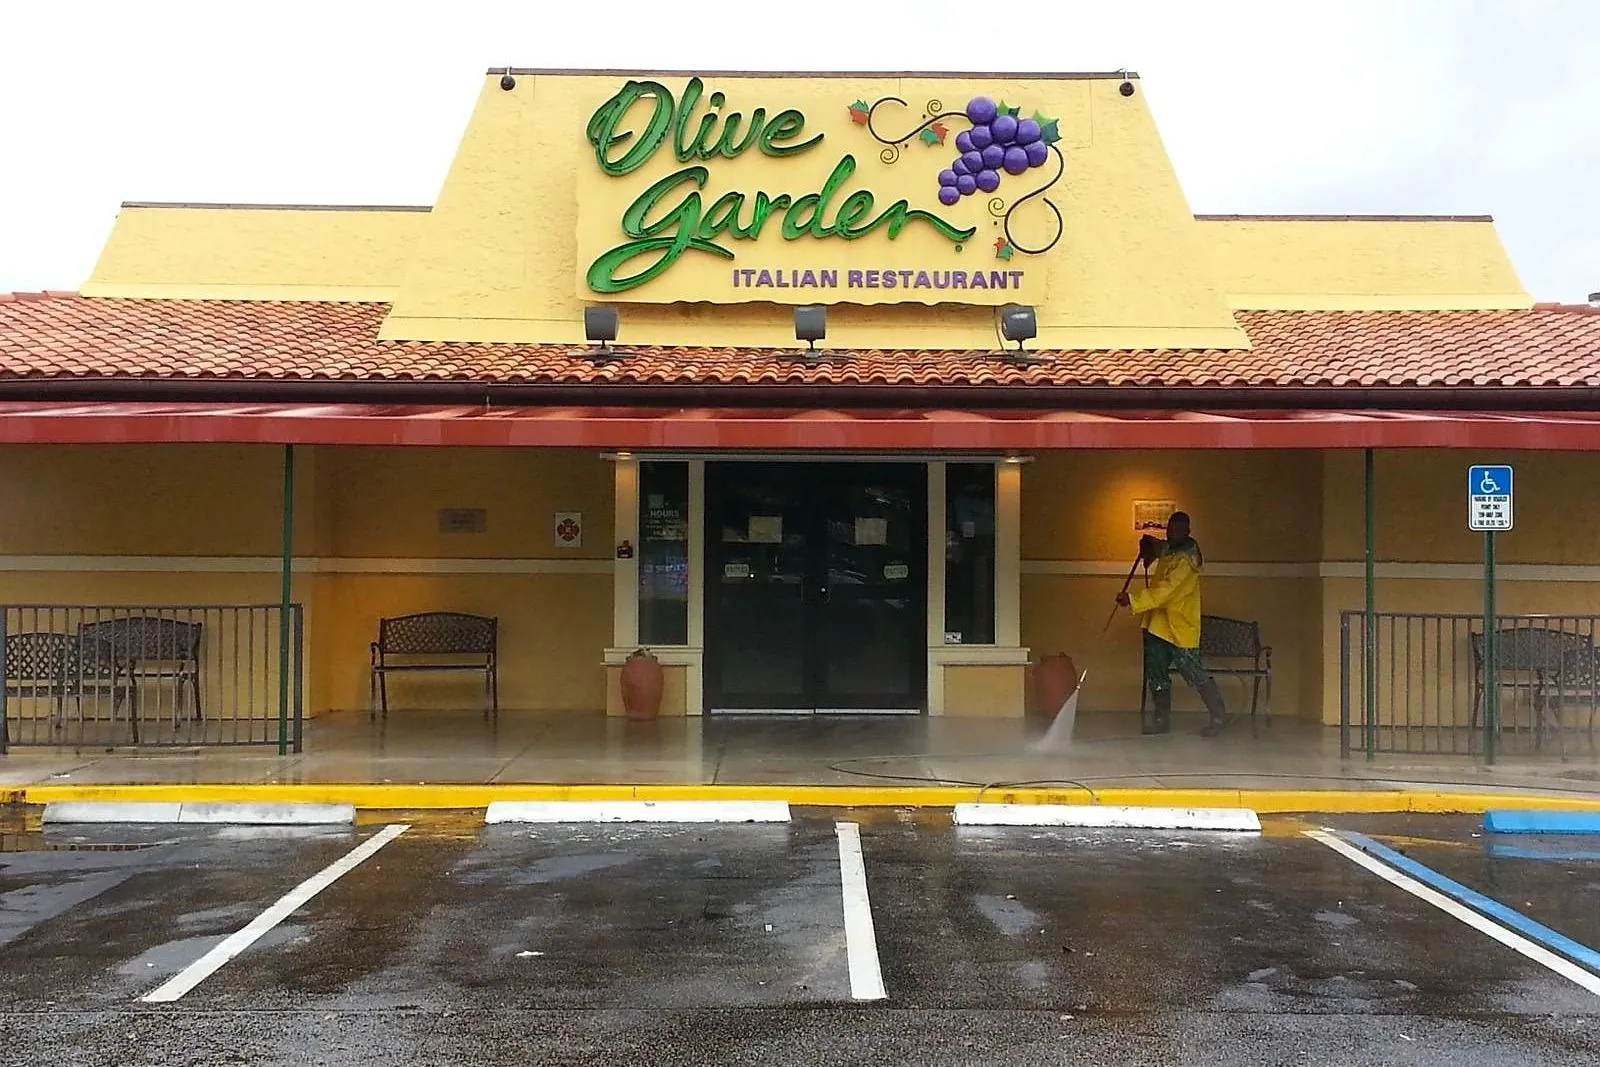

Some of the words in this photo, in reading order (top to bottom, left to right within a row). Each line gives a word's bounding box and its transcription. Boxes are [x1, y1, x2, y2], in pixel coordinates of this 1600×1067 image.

[586, 77, 824, 175] Olive
[586, 154, 976, 293] Garden
[733, 269, 837, 288] ITALIAN
[848, 270, 1024, 290] RESTAURANT
